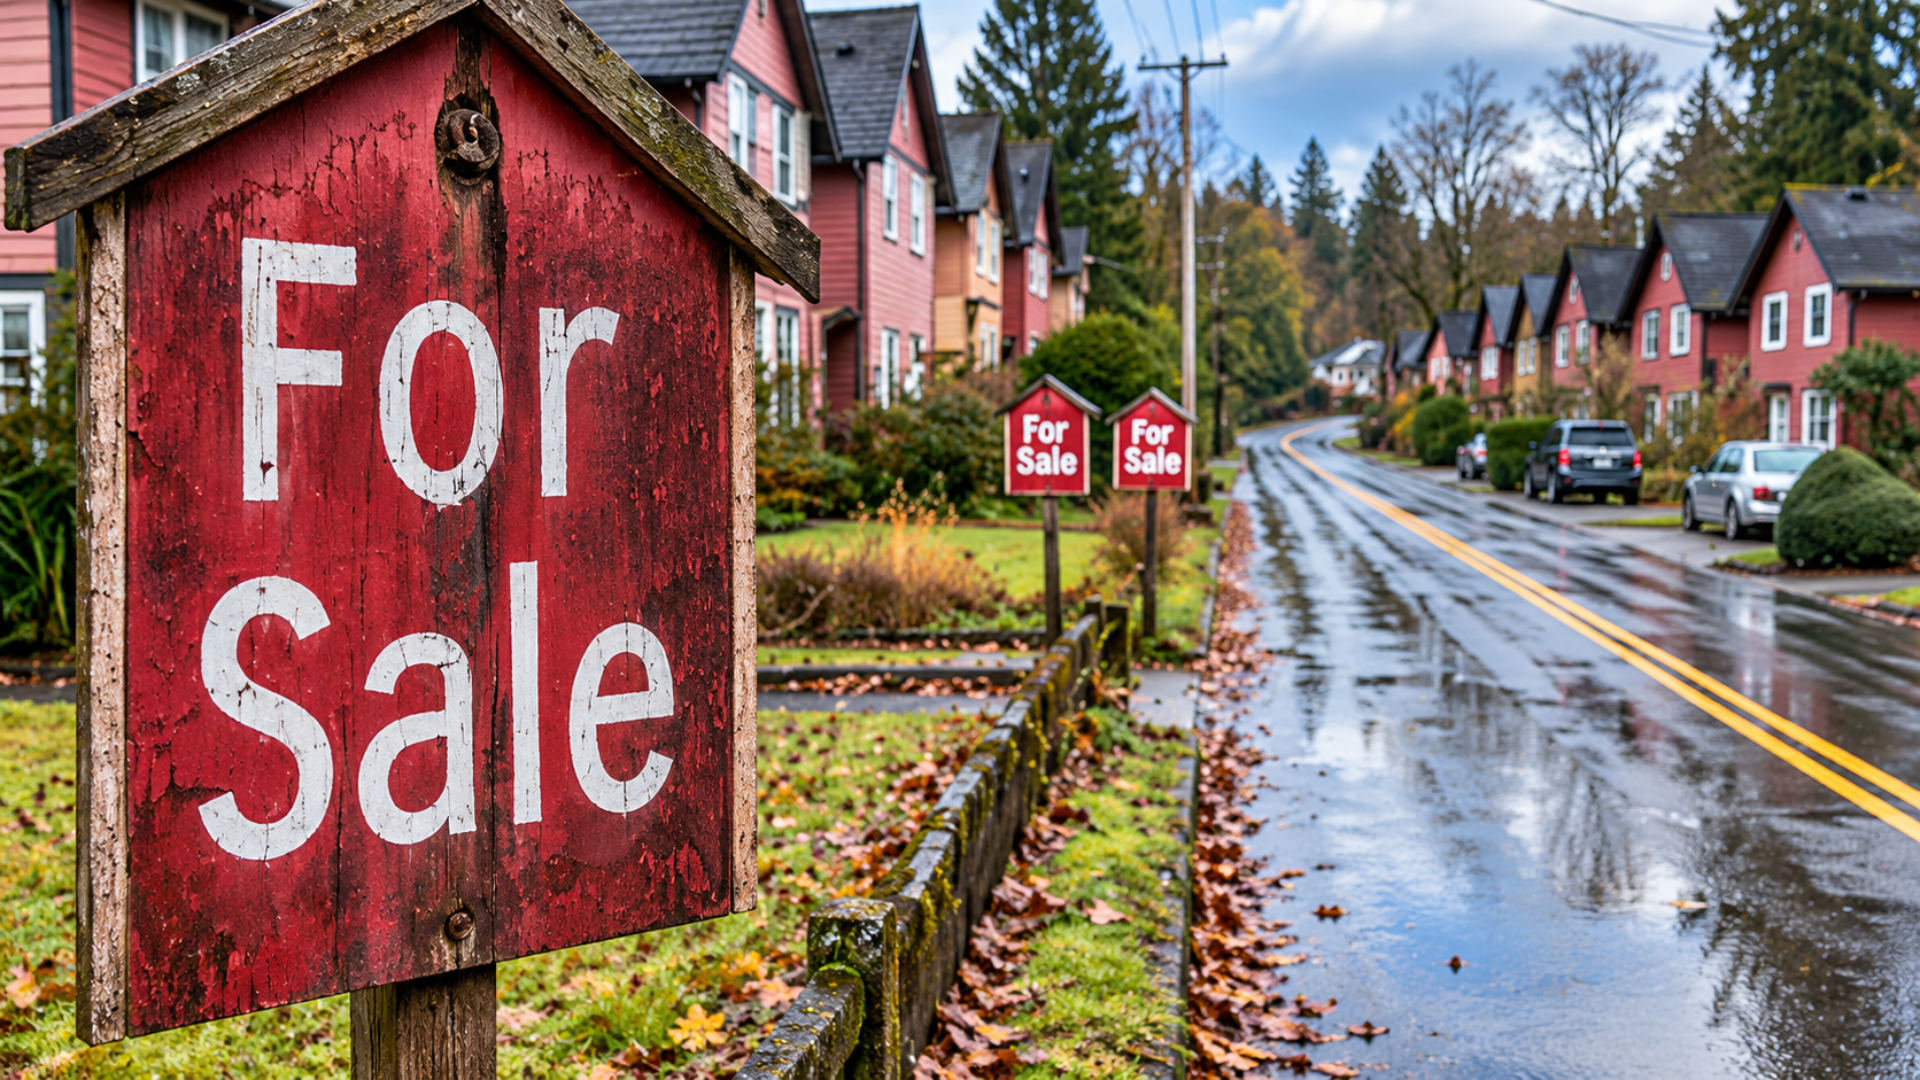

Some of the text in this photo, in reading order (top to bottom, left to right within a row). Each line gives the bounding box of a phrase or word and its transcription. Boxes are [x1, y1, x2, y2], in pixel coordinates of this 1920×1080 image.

[241, 238, 620, 506] For
[1022, 413, 1070, 444] For
[1131, 418, 1175, 445] For
[1016, 445, 1078, 475] Sale
[1124, 446, 1182, 475] Sale
[198, 561, 675, 861] Sale
